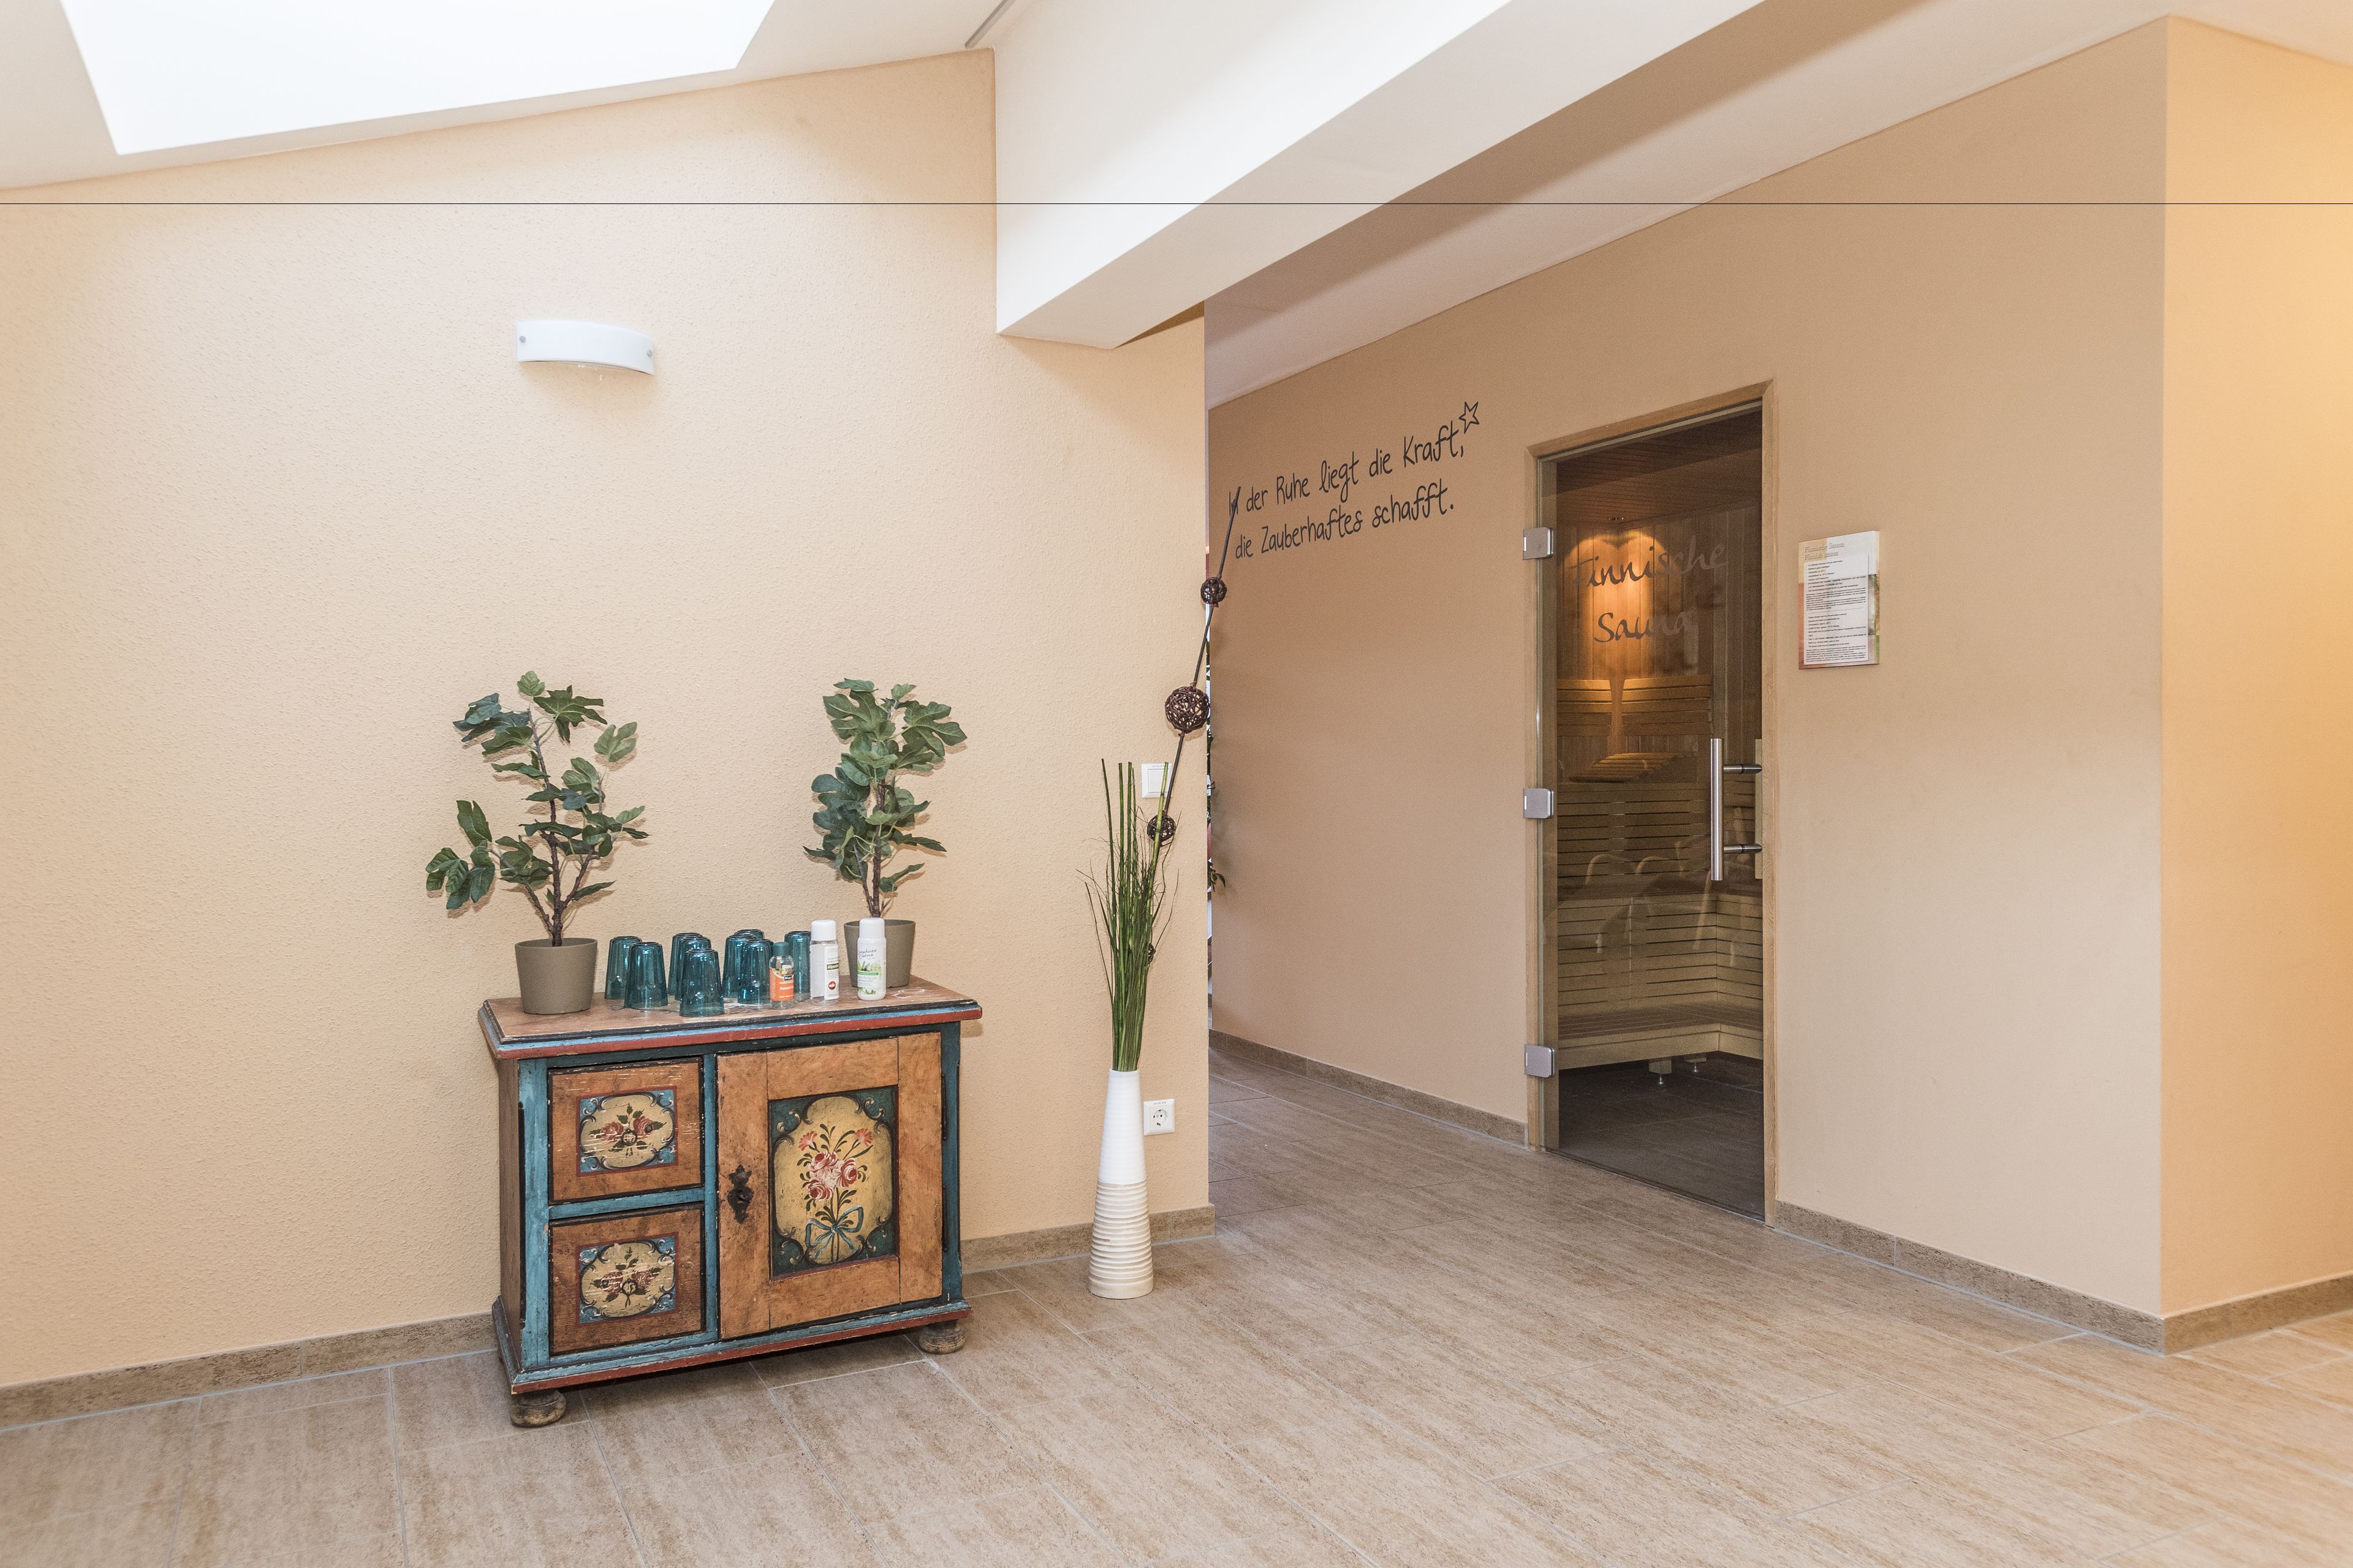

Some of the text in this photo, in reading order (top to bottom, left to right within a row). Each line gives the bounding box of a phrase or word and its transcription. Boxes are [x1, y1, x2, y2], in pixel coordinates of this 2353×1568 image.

[1246, 487, 1268, 512] der
[1276, 472, 1311, 506] Ruhe
[1319, 450, 1360, 504] liegt
[1368, 448, 1393, 478] die
[1403, 420, 1464, 469] Kraft,
[1235, 477, 1455, 559] die Zauberhaftes schafft.
[1570, 535, 1729, 588] Finnische
[1593, 611, 1696, 643] Sauna
